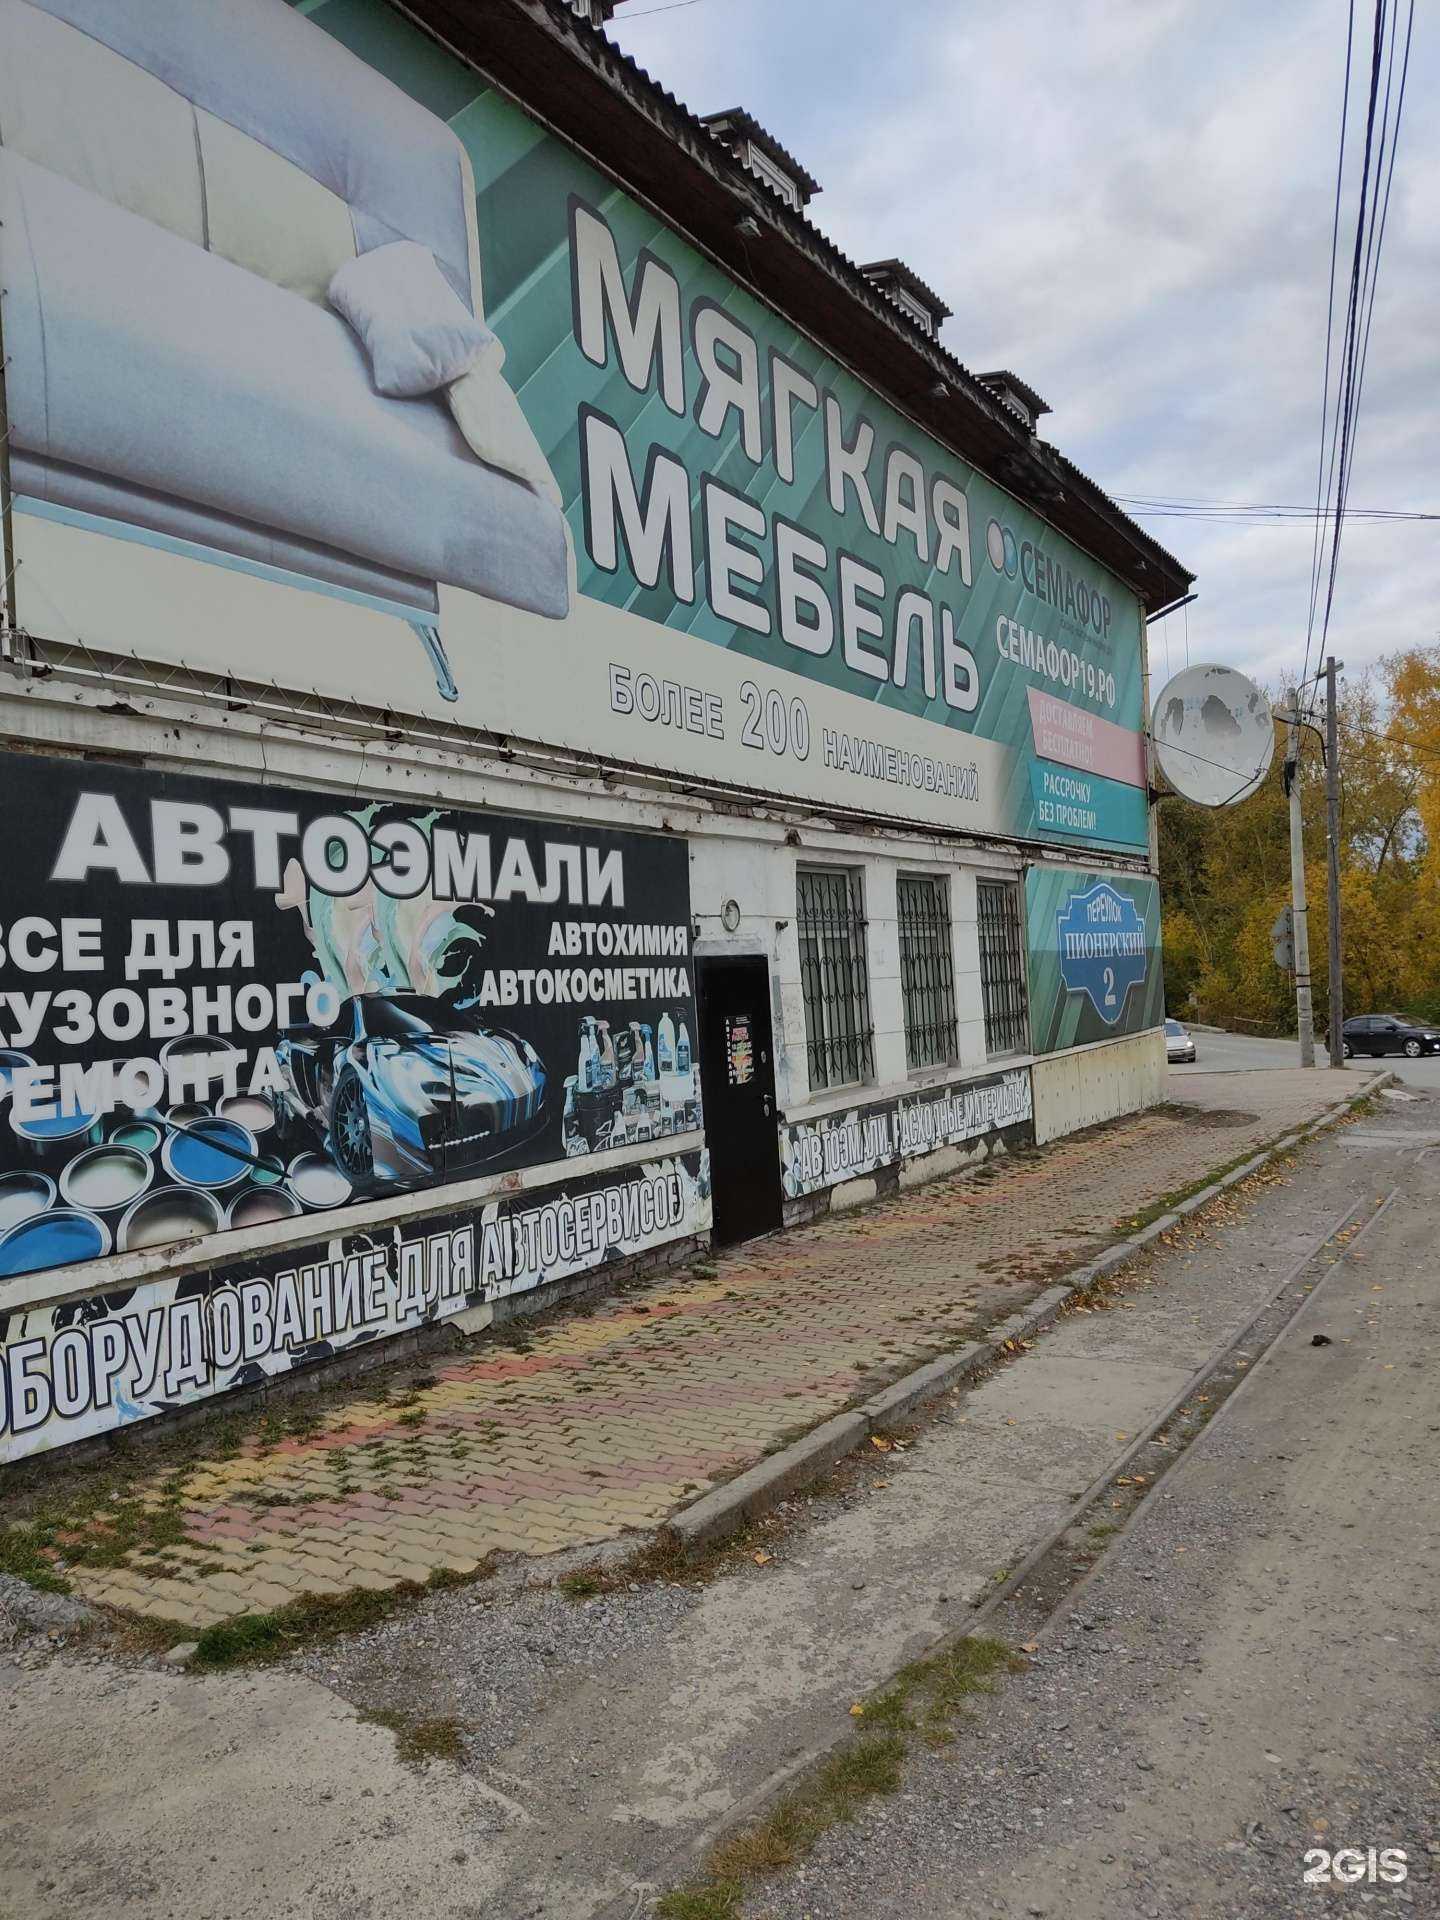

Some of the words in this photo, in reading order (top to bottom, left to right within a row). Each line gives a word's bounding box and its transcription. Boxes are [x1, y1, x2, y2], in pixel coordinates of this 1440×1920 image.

[569, 195, 973, 588] МЯГКАЯ
[579, 402, 980, 713] МЕБЕЛЬ
[1020, 541, 1111, 639] СЕМАФОР
[997, 615, 1116, 709] СЕМАФОР19.РФ
[608, 663, 724, 740] БОЛЕЕ
[739, 680, 810, 761] 200
[822, 727, 979, 802] НАИМЕНОВАНИЙ
[1039, 799, 1054, 823] БЕЗ
[1056, 803, 1097, 831] ПРОБЛЕМ!
[1043, 772, 1091, 803] РАССРОЧКУ
[50, 791, 626, 908] АВТОЭМАЛИ
[0, 916, 104, 973] СЕ
[124, 919, 255, 981] ДЛЯ
[547, 921, 688, 956] АВТОХИМИЯ
[1065, 926, 1145, 960] ПИОНЕРСКИЙ
[0, 980, 341, 1049] УЗОВНОГО
[478, 967, 692, 1007] АВТОКОСМЕТИКА
[1103, 967, 1116, 1006] 2
[0, 1046, 291, 1123] ЕМОНТА
[0, 1254, 390, 1440] БОРУДОВАНИЕ
[395, 1224, 474, 1320] ДЛЯ
[480, 1172, 685, 1289] АВТОСЕРВИСОВ
